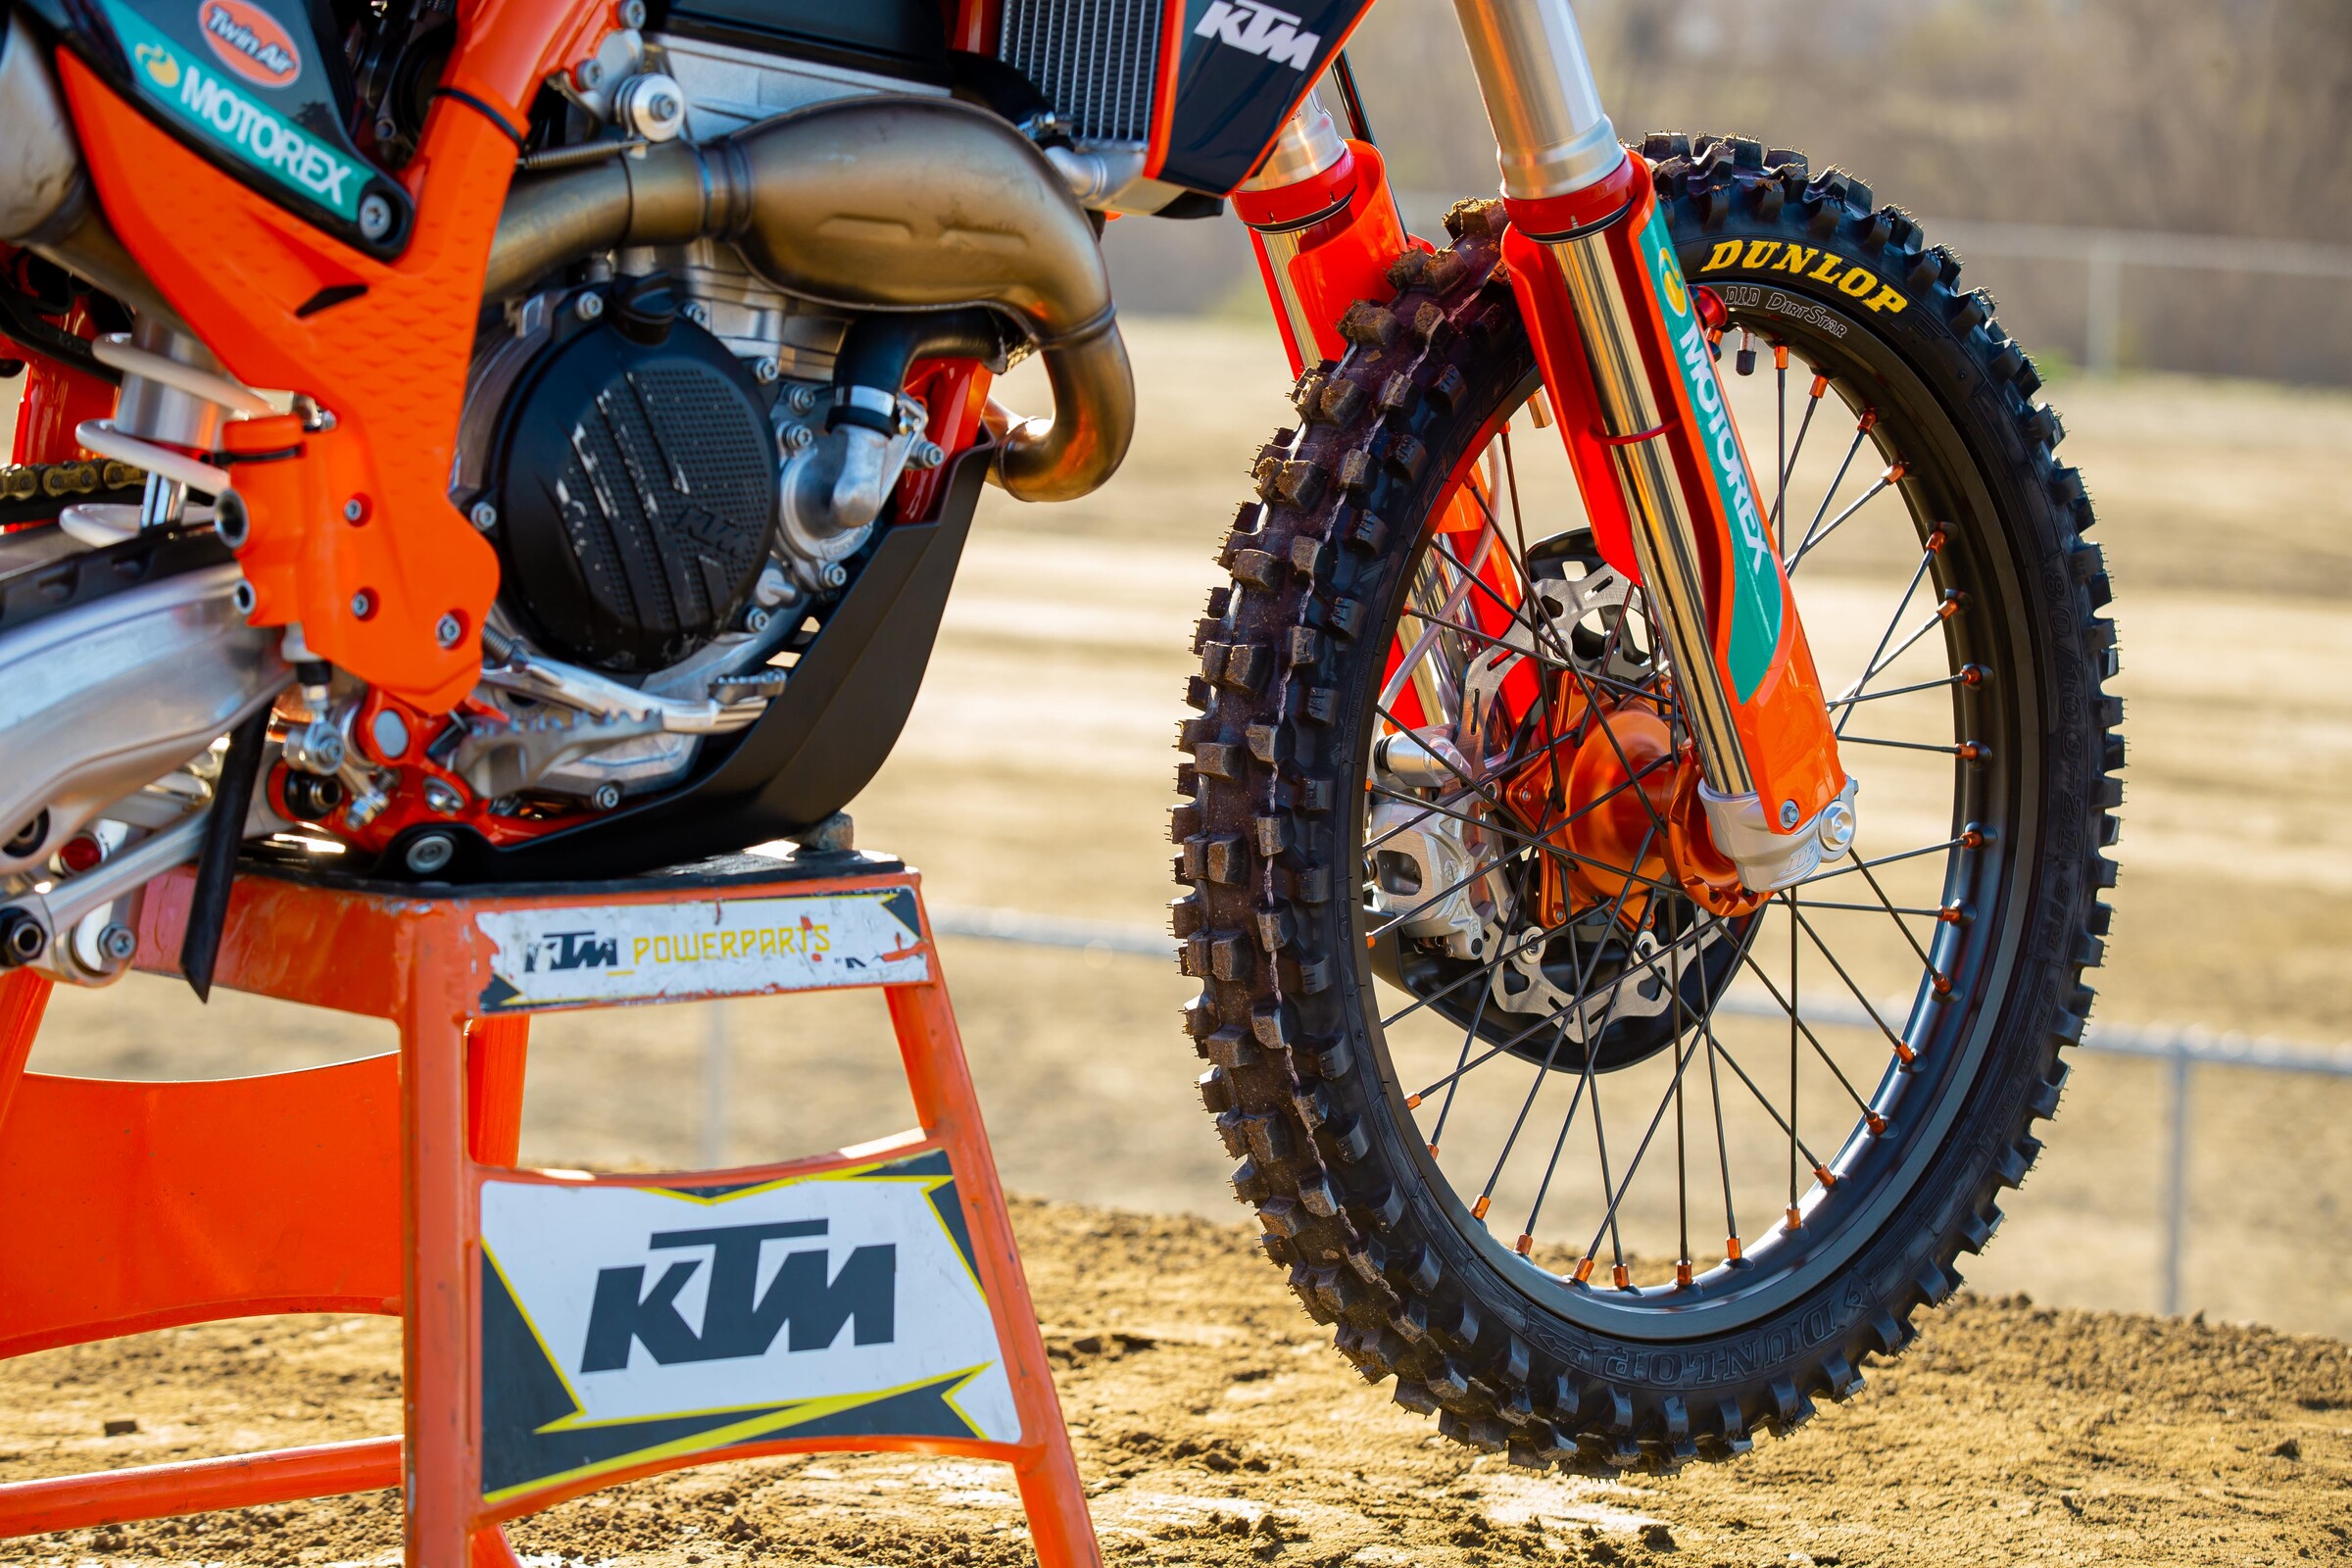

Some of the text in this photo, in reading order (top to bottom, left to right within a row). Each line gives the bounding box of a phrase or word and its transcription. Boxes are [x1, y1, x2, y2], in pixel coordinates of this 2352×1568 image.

[207, 6, 297, 75] Twin Air
[1194, 0, 1321, 72] KTM
[180, 65, 351, 206] MOTOREX
[1700, 238, 1909, 314] DUNLOP
[1679, 320, 1771, 575] MOTOREX
[2041, 571, 2084, 854] 80/100-21
[524, 924, 831, 973] KTM POWERPARTS
[580, 1217, 897, 1374] KTM
[1601, 1299, 1837, 1385] DUNLOP
